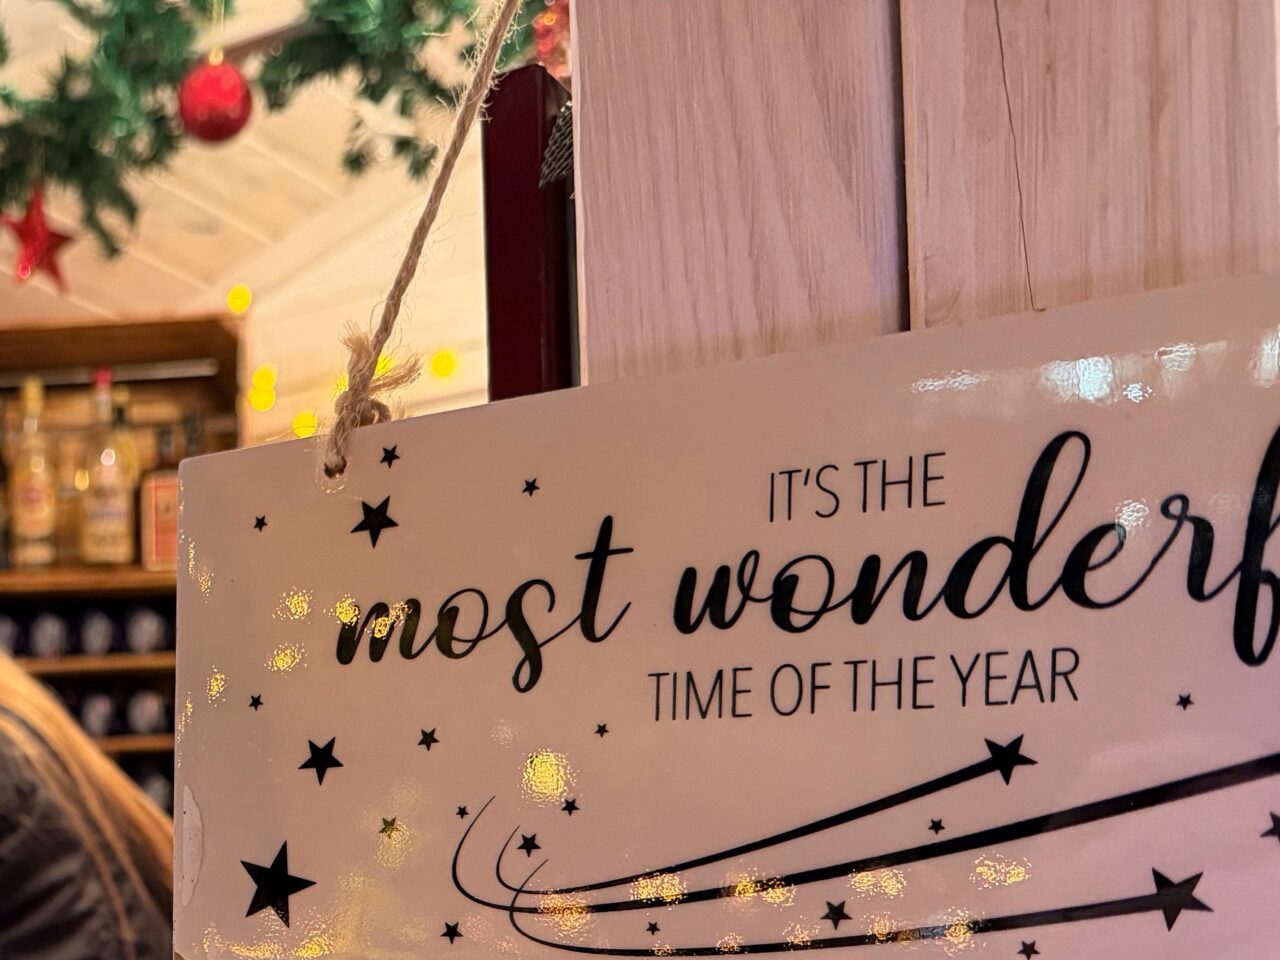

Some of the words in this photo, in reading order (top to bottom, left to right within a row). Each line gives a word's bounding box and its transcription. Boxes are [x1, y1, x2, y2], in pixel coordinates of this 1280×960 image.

[769, 464, 840, 523] IT'S
[853, 452, 947, 514] THE
[335, 515, 635, 694] most
[647, 667, 753, 722] TIME
[769, 662, 833, 717] OF
[843, 656, 936, 713] THE
[949, 647, 1080, 708] YEAR
